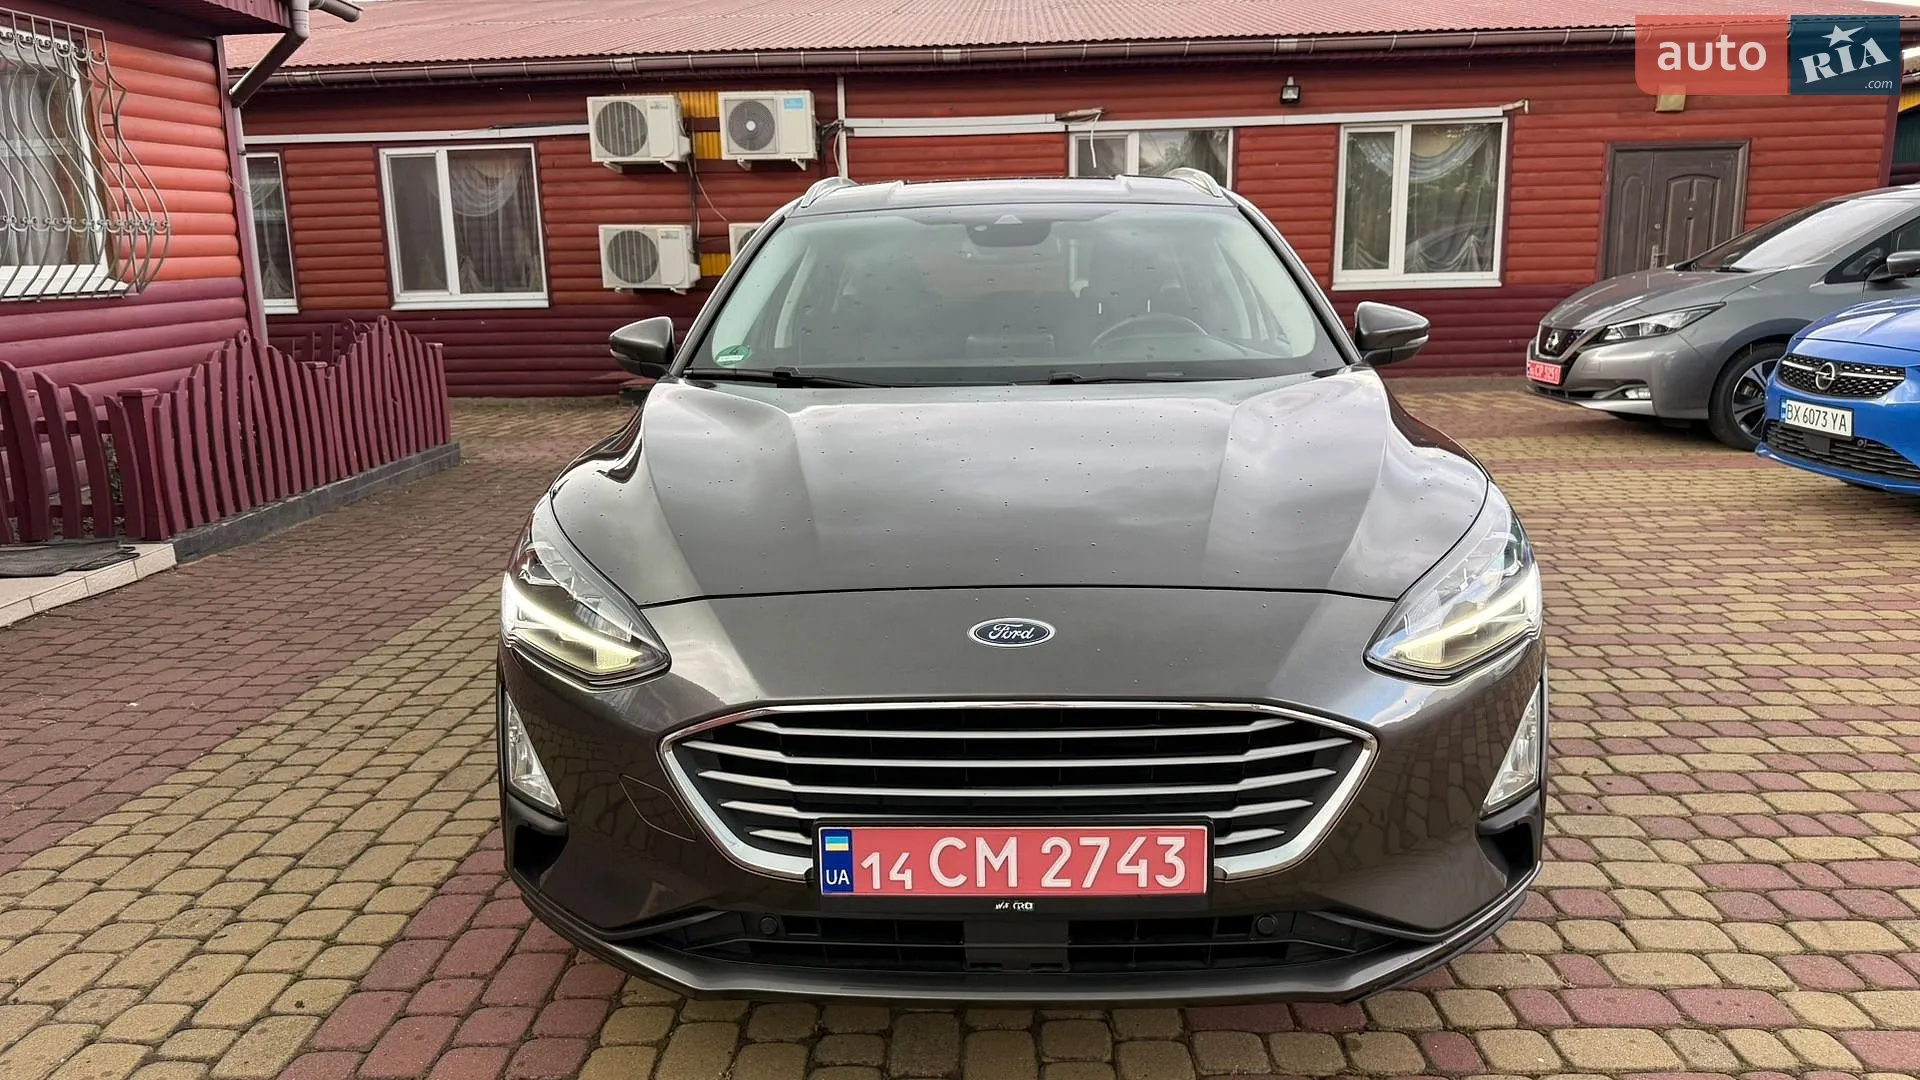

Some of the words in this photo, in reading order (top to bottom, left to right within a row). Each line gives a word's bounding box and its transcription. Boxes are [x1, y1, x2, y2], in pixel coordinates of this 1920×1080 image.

[1786, 403, 1801, 423] BX
[1802, 407, 1828, 428] 6073
[1831, 412, 1847, 432] YA
[988, 623, 1035, 640] Ford
[860, 852, 913, 890] 14
[929, 836, 1018, 889] CM
[1040, 836, 1186, 889] 2743
[826, 870, 850, 885] UA
